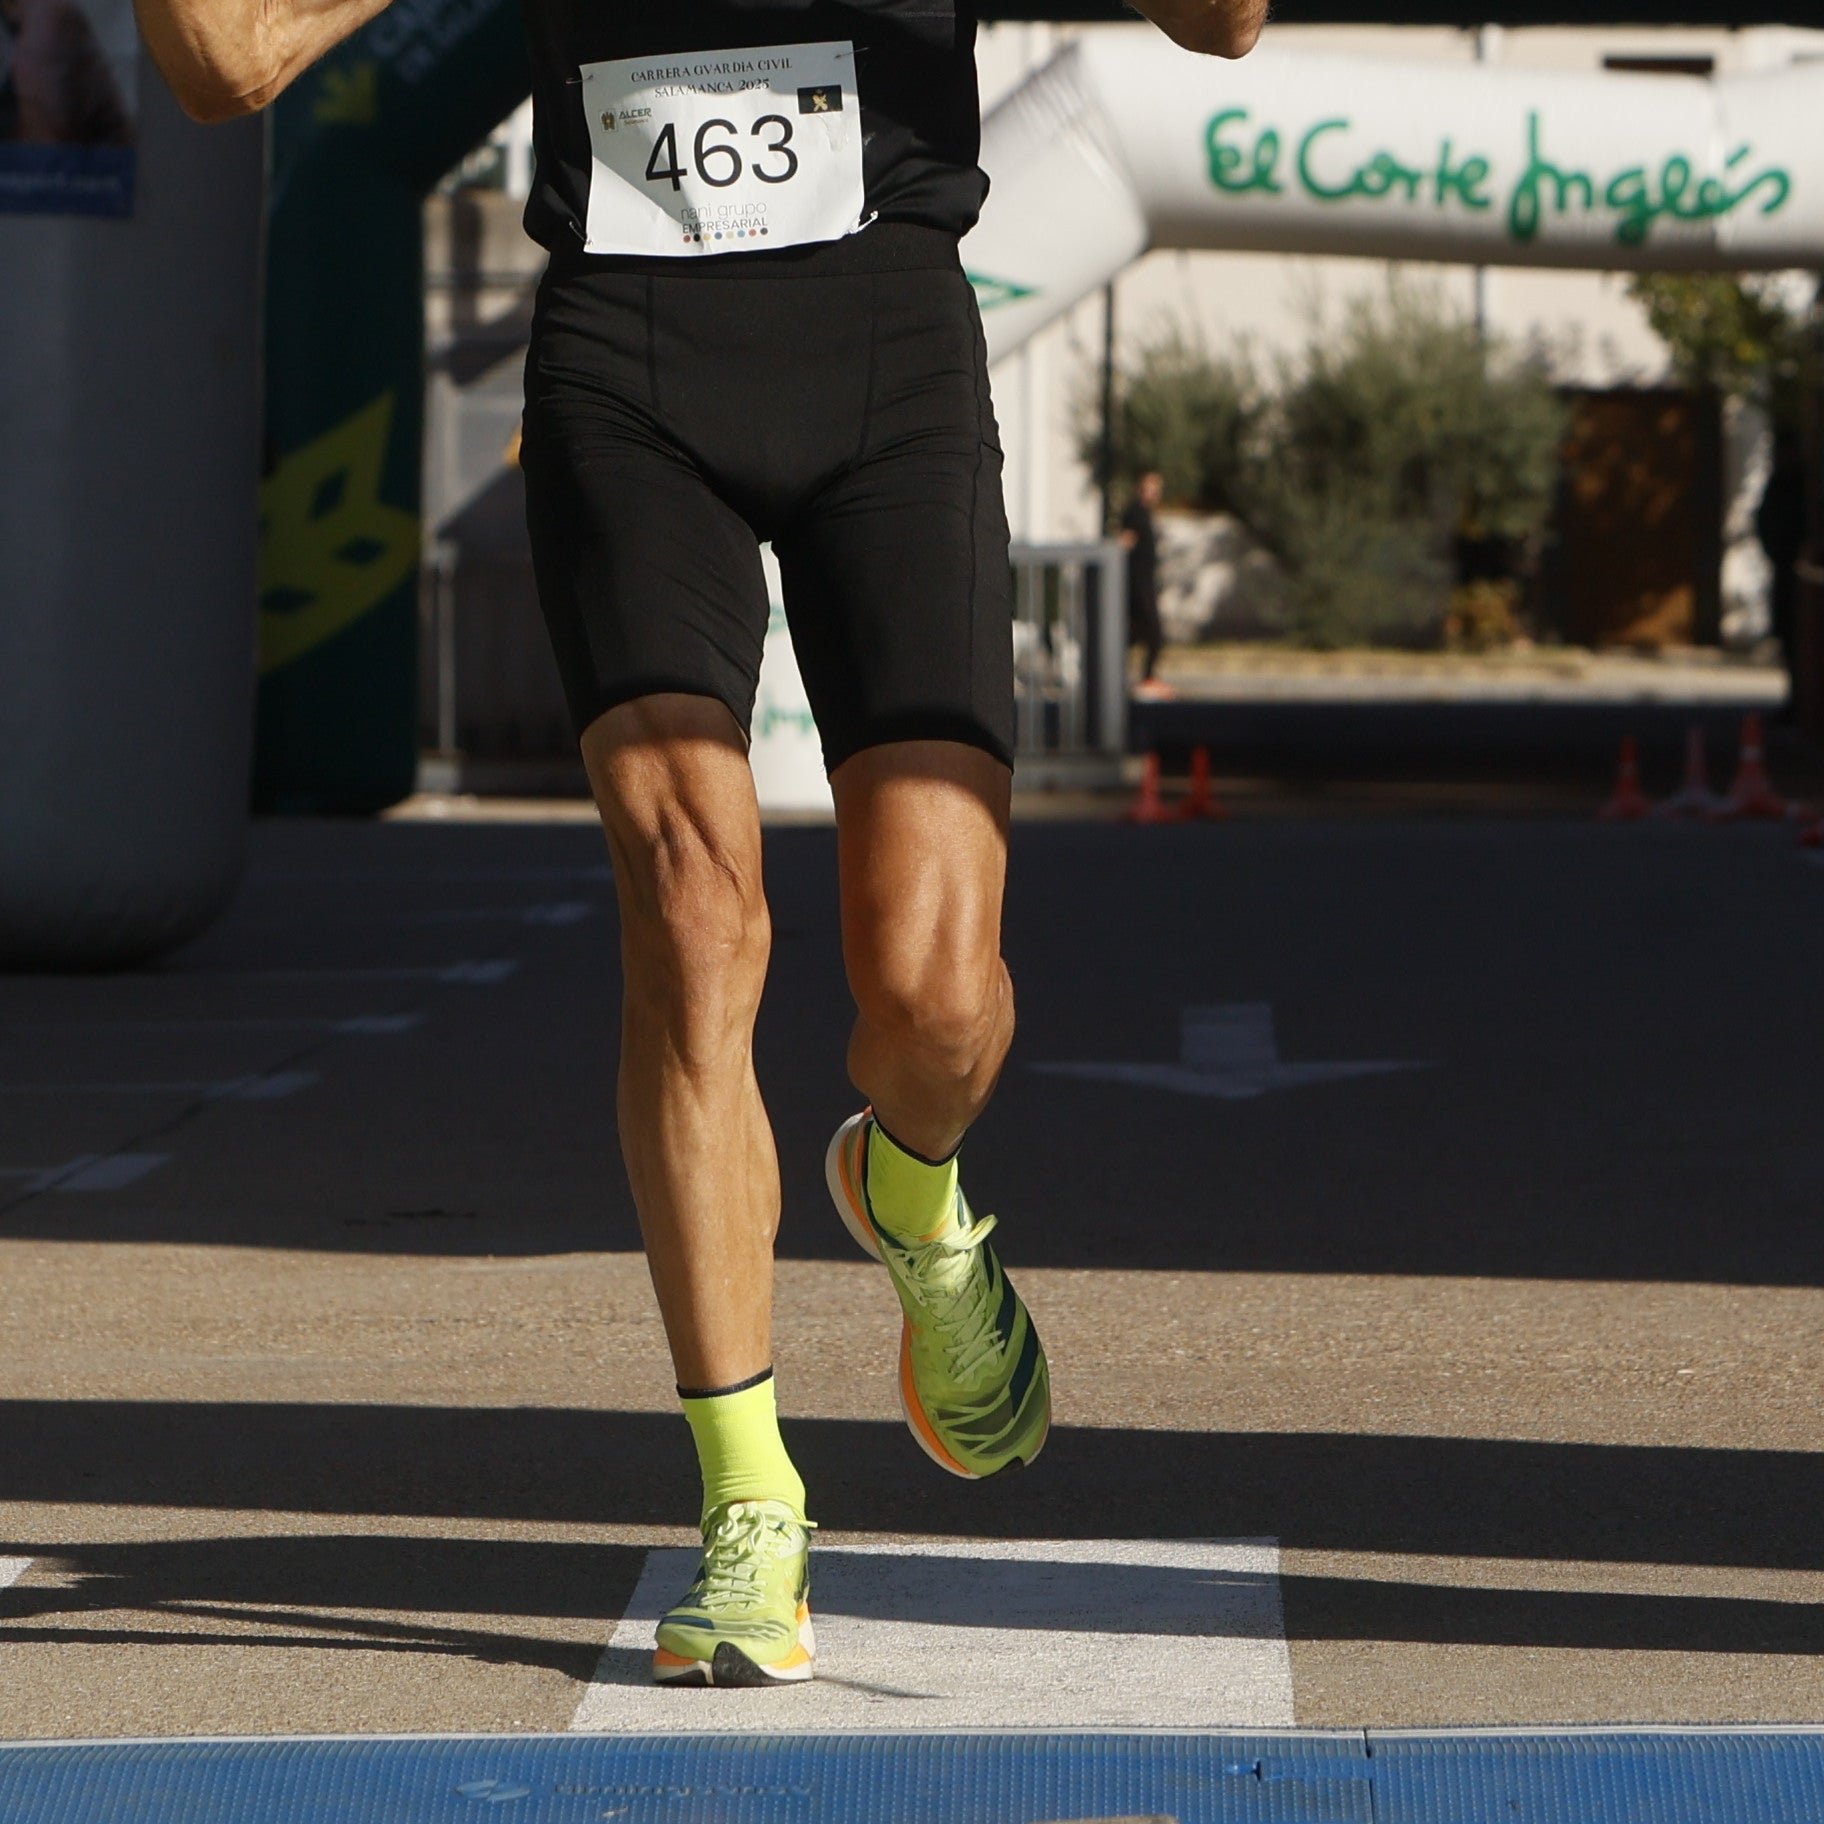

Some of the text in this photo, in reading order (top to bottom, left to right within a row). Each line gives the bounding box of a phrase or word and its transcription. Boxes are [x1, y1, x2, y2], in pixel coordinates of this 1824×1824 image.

[631, 66, 691, 83] CARRERA
[758, 57, 793, 72] CIVIL
[655, 78, 770, 98] SALAMANCA 2025
[644, 113, 800, 193] 463
[1204, 108, 1792, 247] El Corte Inglés
[681, 201, 767, 221] nani grupo
[682, 217, 768, 234] EMPRESARIAL
